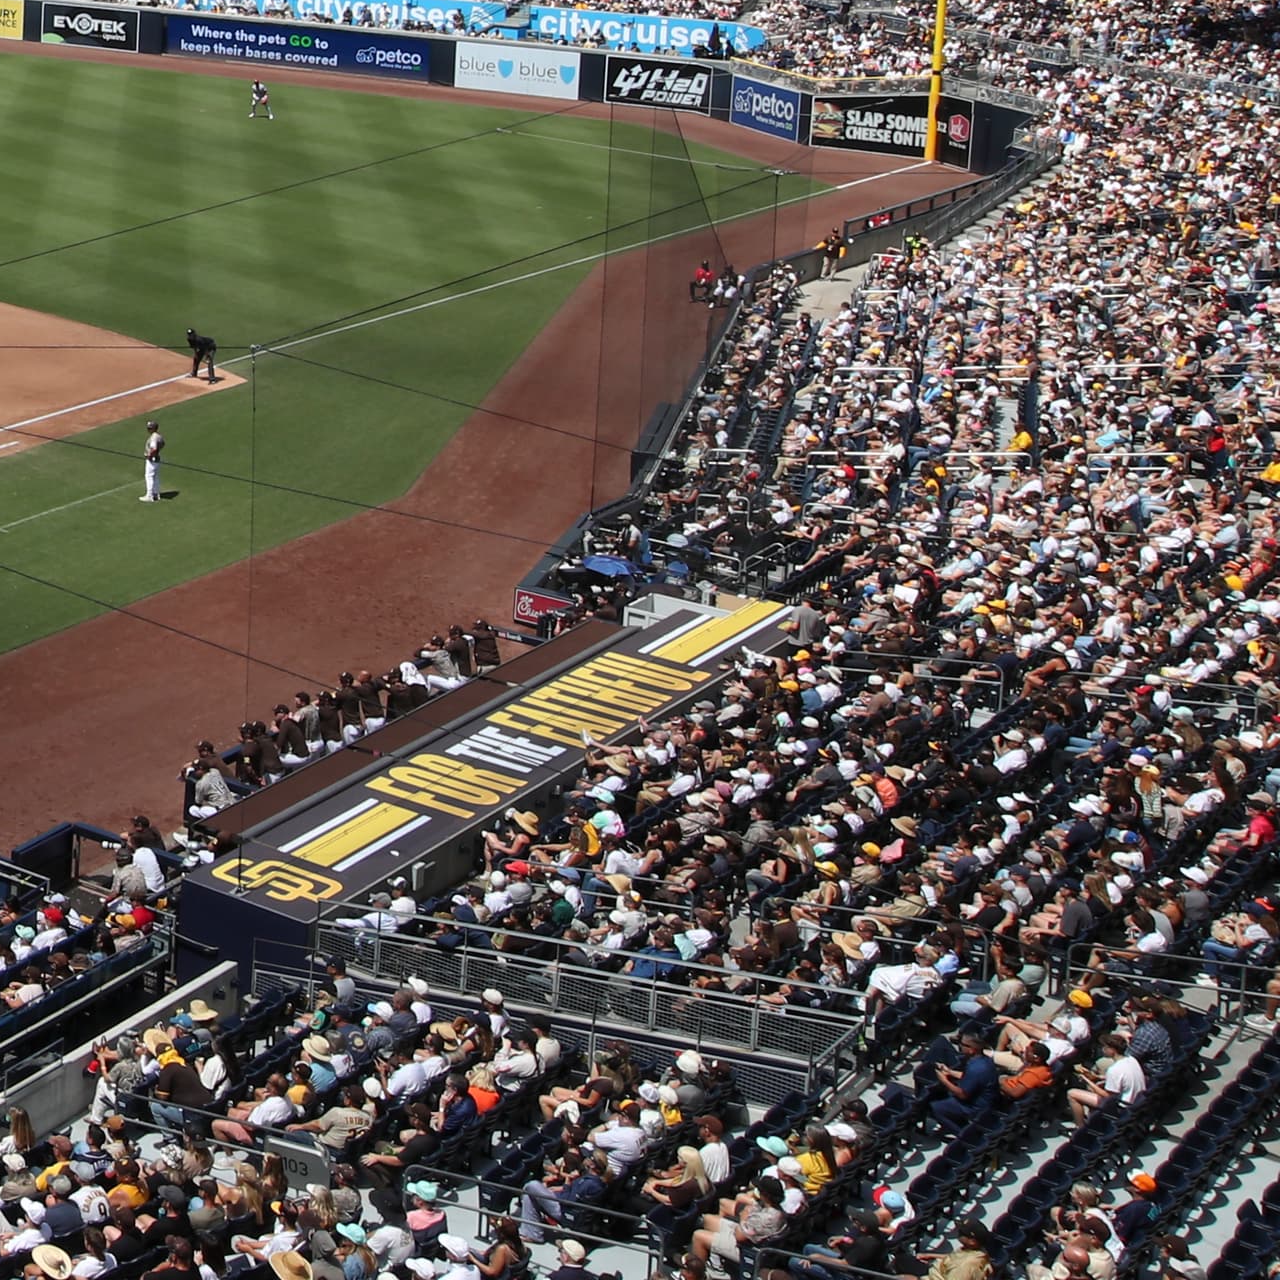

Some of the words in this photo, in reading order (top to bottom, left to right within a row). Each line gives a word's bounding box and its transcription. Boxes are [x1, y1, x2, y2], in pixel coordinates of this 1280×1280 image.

[191, 24, 233, 41] Where
[236, 29, 255, 42] the
[259, 31, 287, 46] pets
[289, 34, 312, 48] GO
[314, 38, 329, 50] to
[540, 11, 718, 49] citycruise
[181, 39, 211, 55] keep
[213, 42, 242, 56] their
[246, 45, 282, 61] bases
[285, 49, 338, 67] covered
[376, 48, 422, 66] petco
[459, 55, 496, 72] blue
[520, 61, 558, 77] blue
[752, 92, 794, 120] petco
[846, 110, 884, 128] SLAP
[886, 114, 929, 133] SOME
[846, 127, 891, 144] CHEESE
[893, 133, 913, 146] ON
[486, 652, 712, 749] FAITHFUL
[445, 726, 566, 772] THE
[365, 753, 528, 819] FOR
